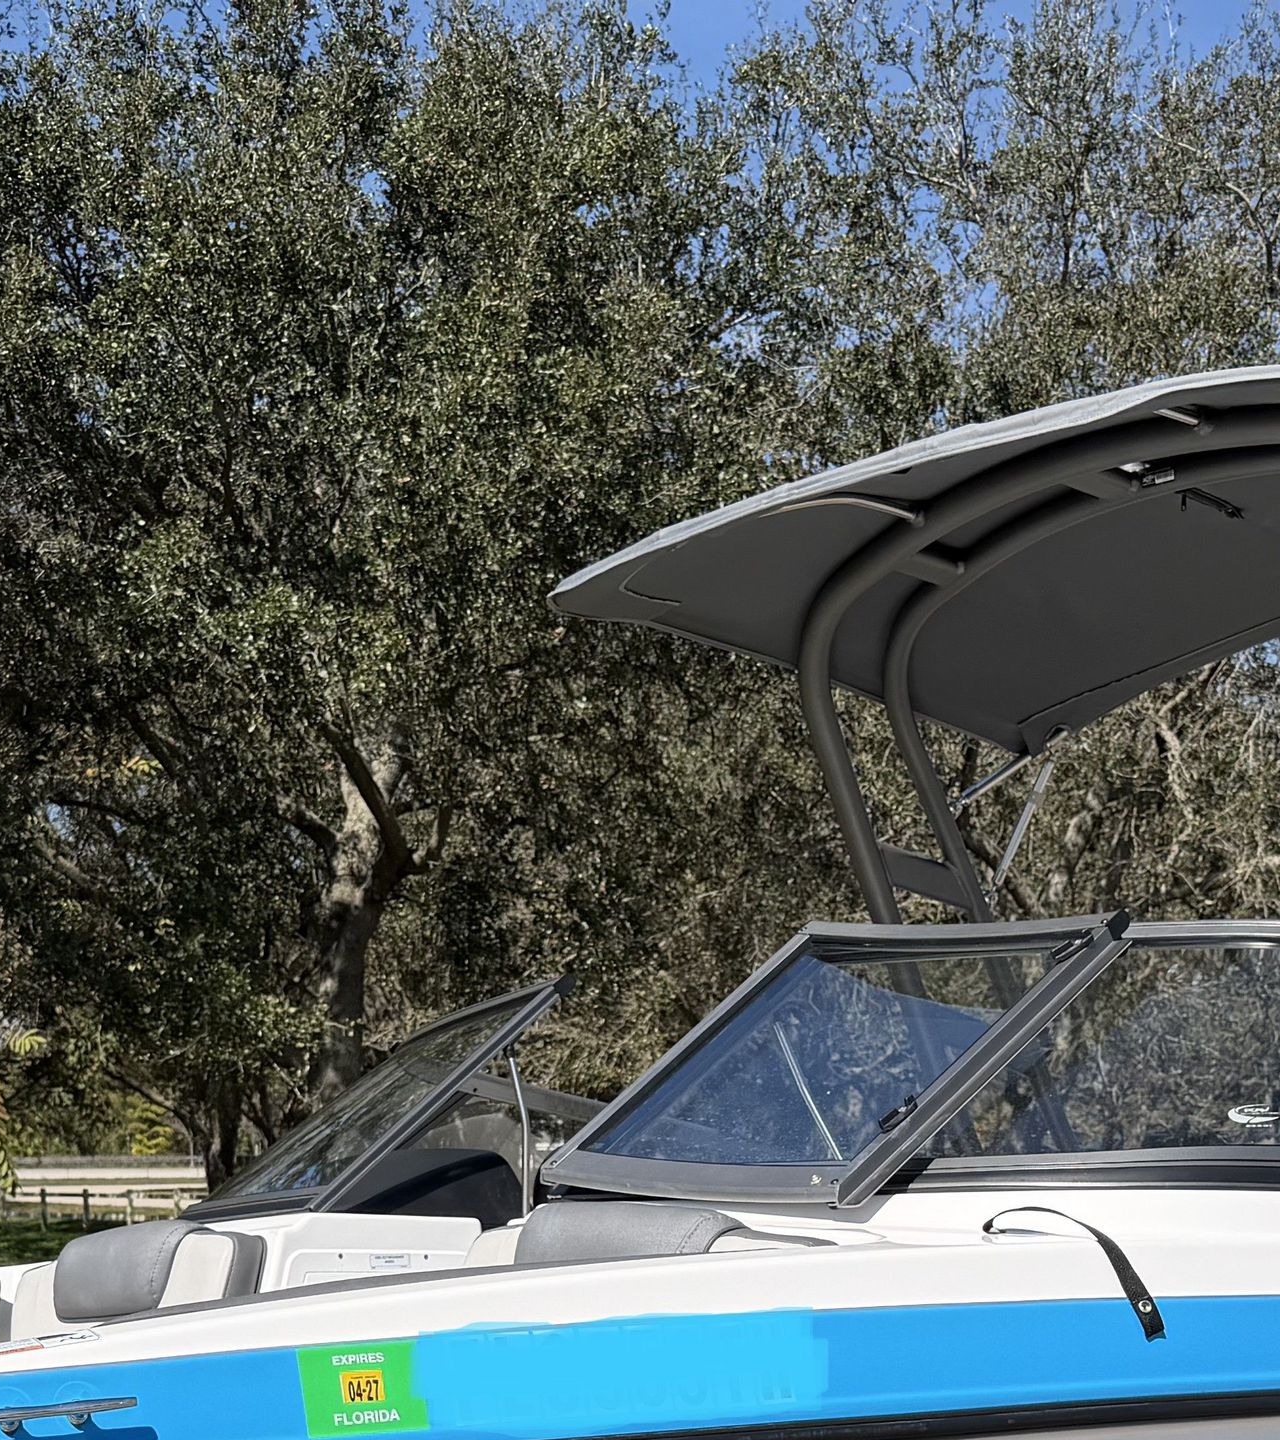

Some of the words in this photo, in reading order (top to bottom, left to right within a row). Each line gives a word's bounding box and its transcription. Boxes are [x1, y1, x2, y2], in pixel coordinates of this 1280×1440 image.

[331, 1352, 385, 1366] EXPIRES
[348, 1379, 379, 1402] 04-27
[333, 1408, 401, 1426] FLORIDA
